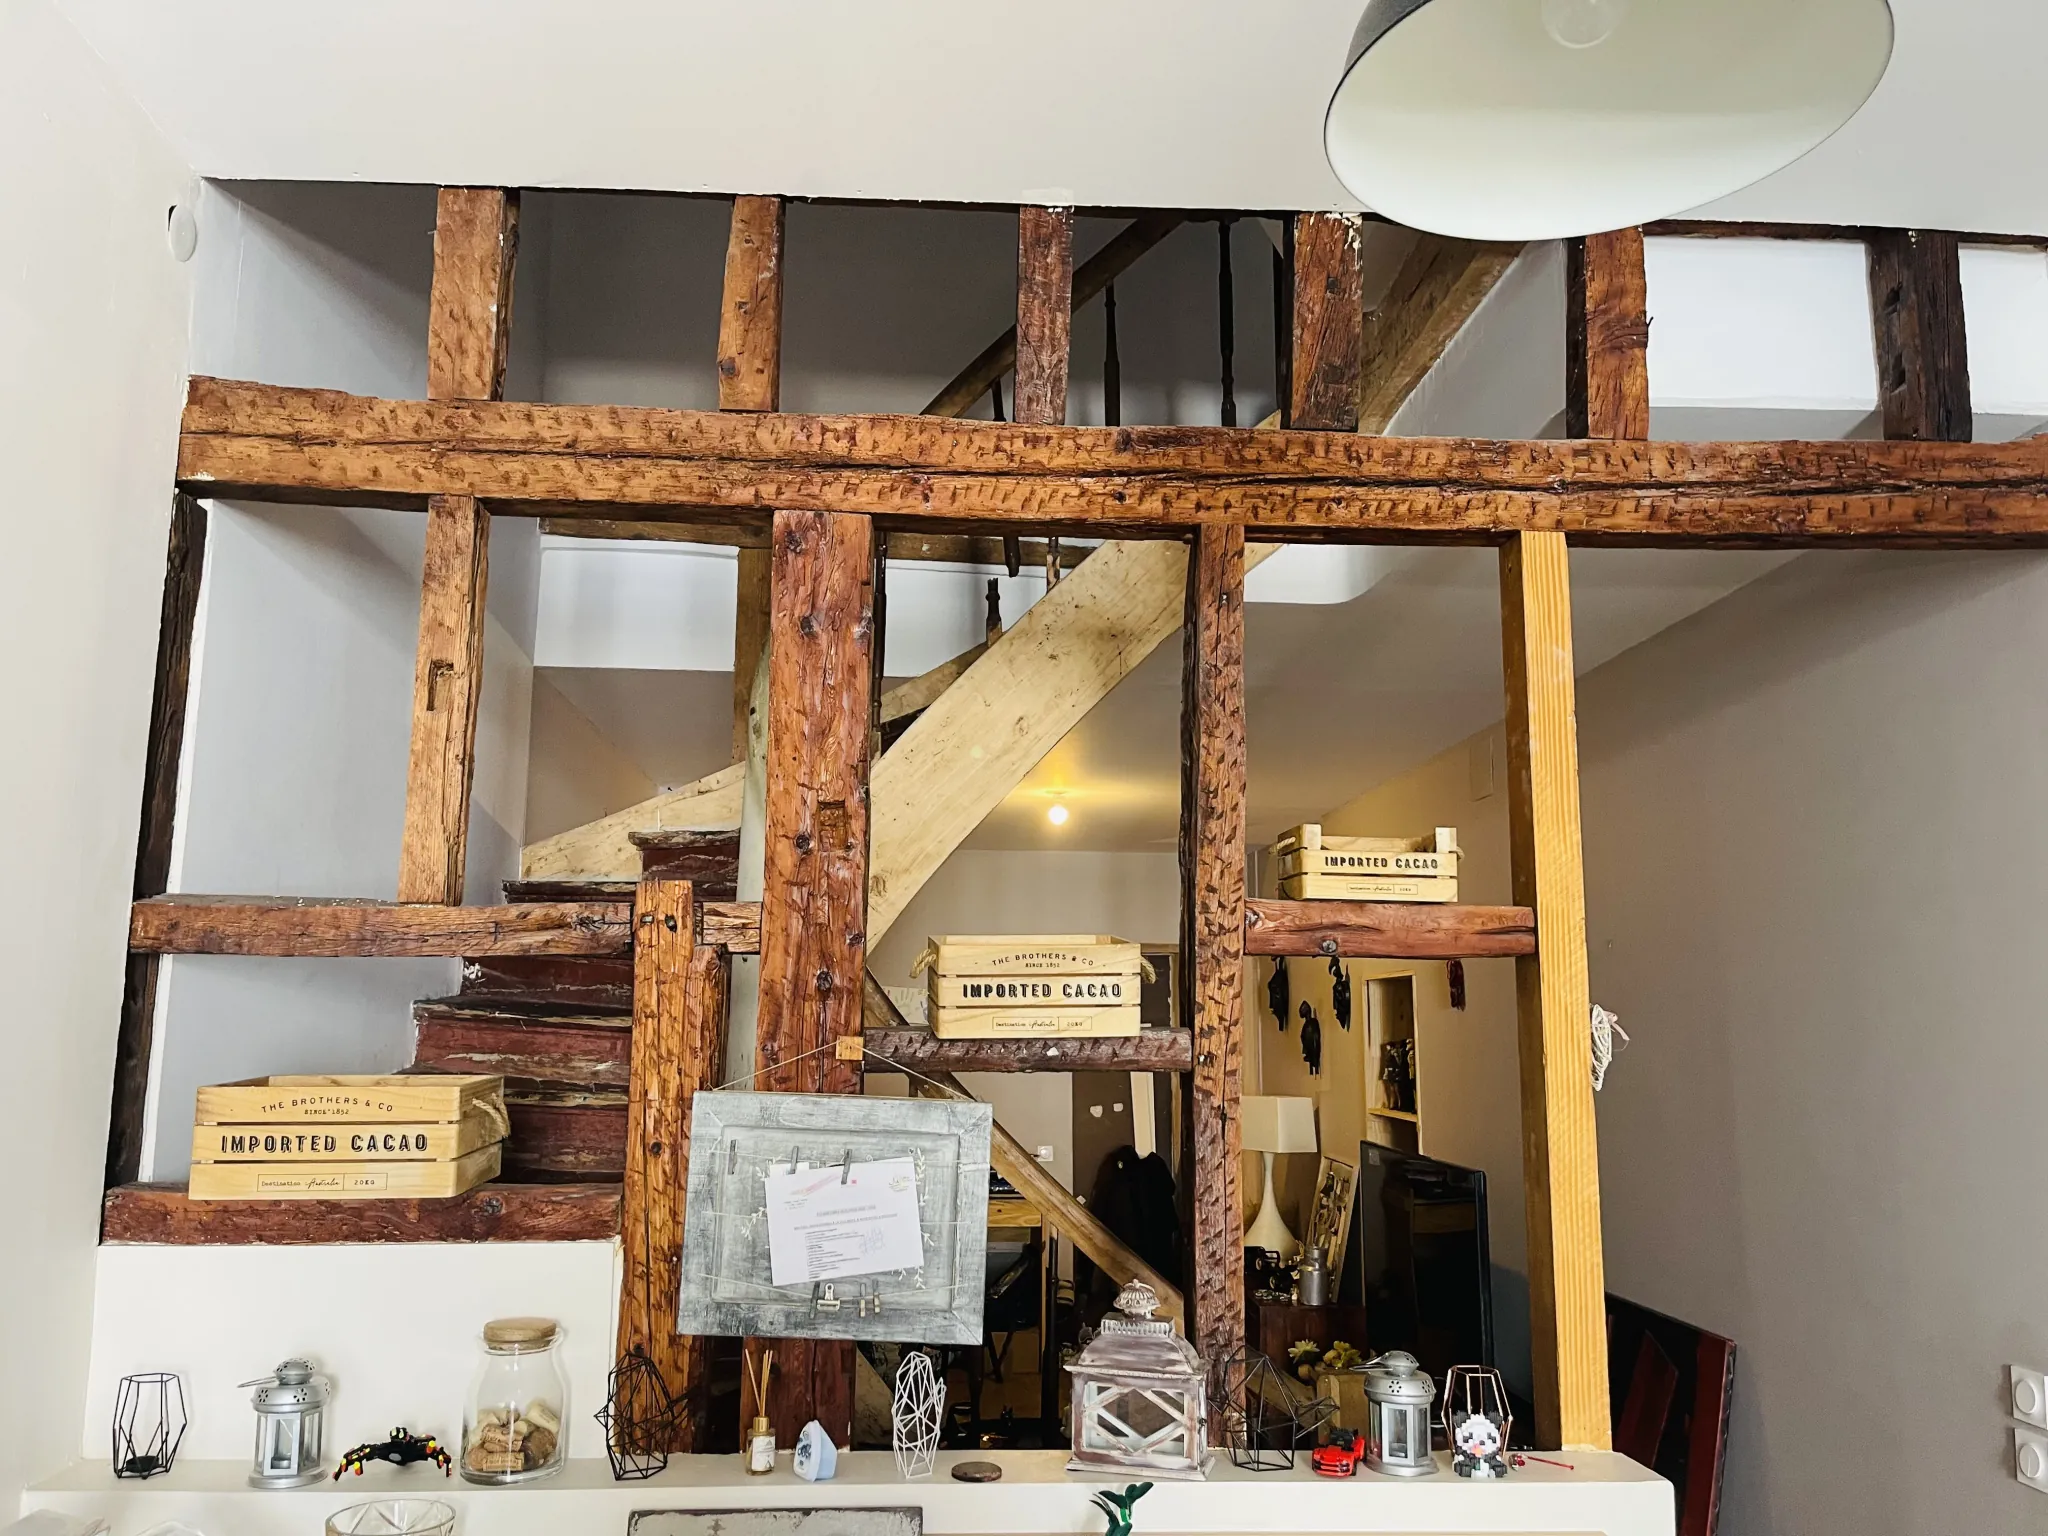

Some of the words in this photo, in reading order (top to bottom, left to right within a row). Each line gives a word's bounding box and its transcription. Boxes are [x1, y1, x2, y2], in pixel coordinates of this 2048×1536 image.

[1325, 856, 1388, 868] IMPORTED
[1395, 858, 1439, 870] CACAO
[991, 956, 1010, 966] THE
[1015, 953, 1067, 961] BROTHERS
[1081, 958, 1094, 966] CO
[962, 983, 1052, 999] IMPORTED
[1062, 983, 1122, 998] CACAO
[261, 1102, 285, 1113] THE
[291, 1096, 359, 1107] BROTHERS
[378, 1102, 393, 1112] CO
[331, 1108, 350, 1116] 1852
[220, 1135, 338, 1154] IMPORTED
[350, 1133, 429, 1152] CACAO
